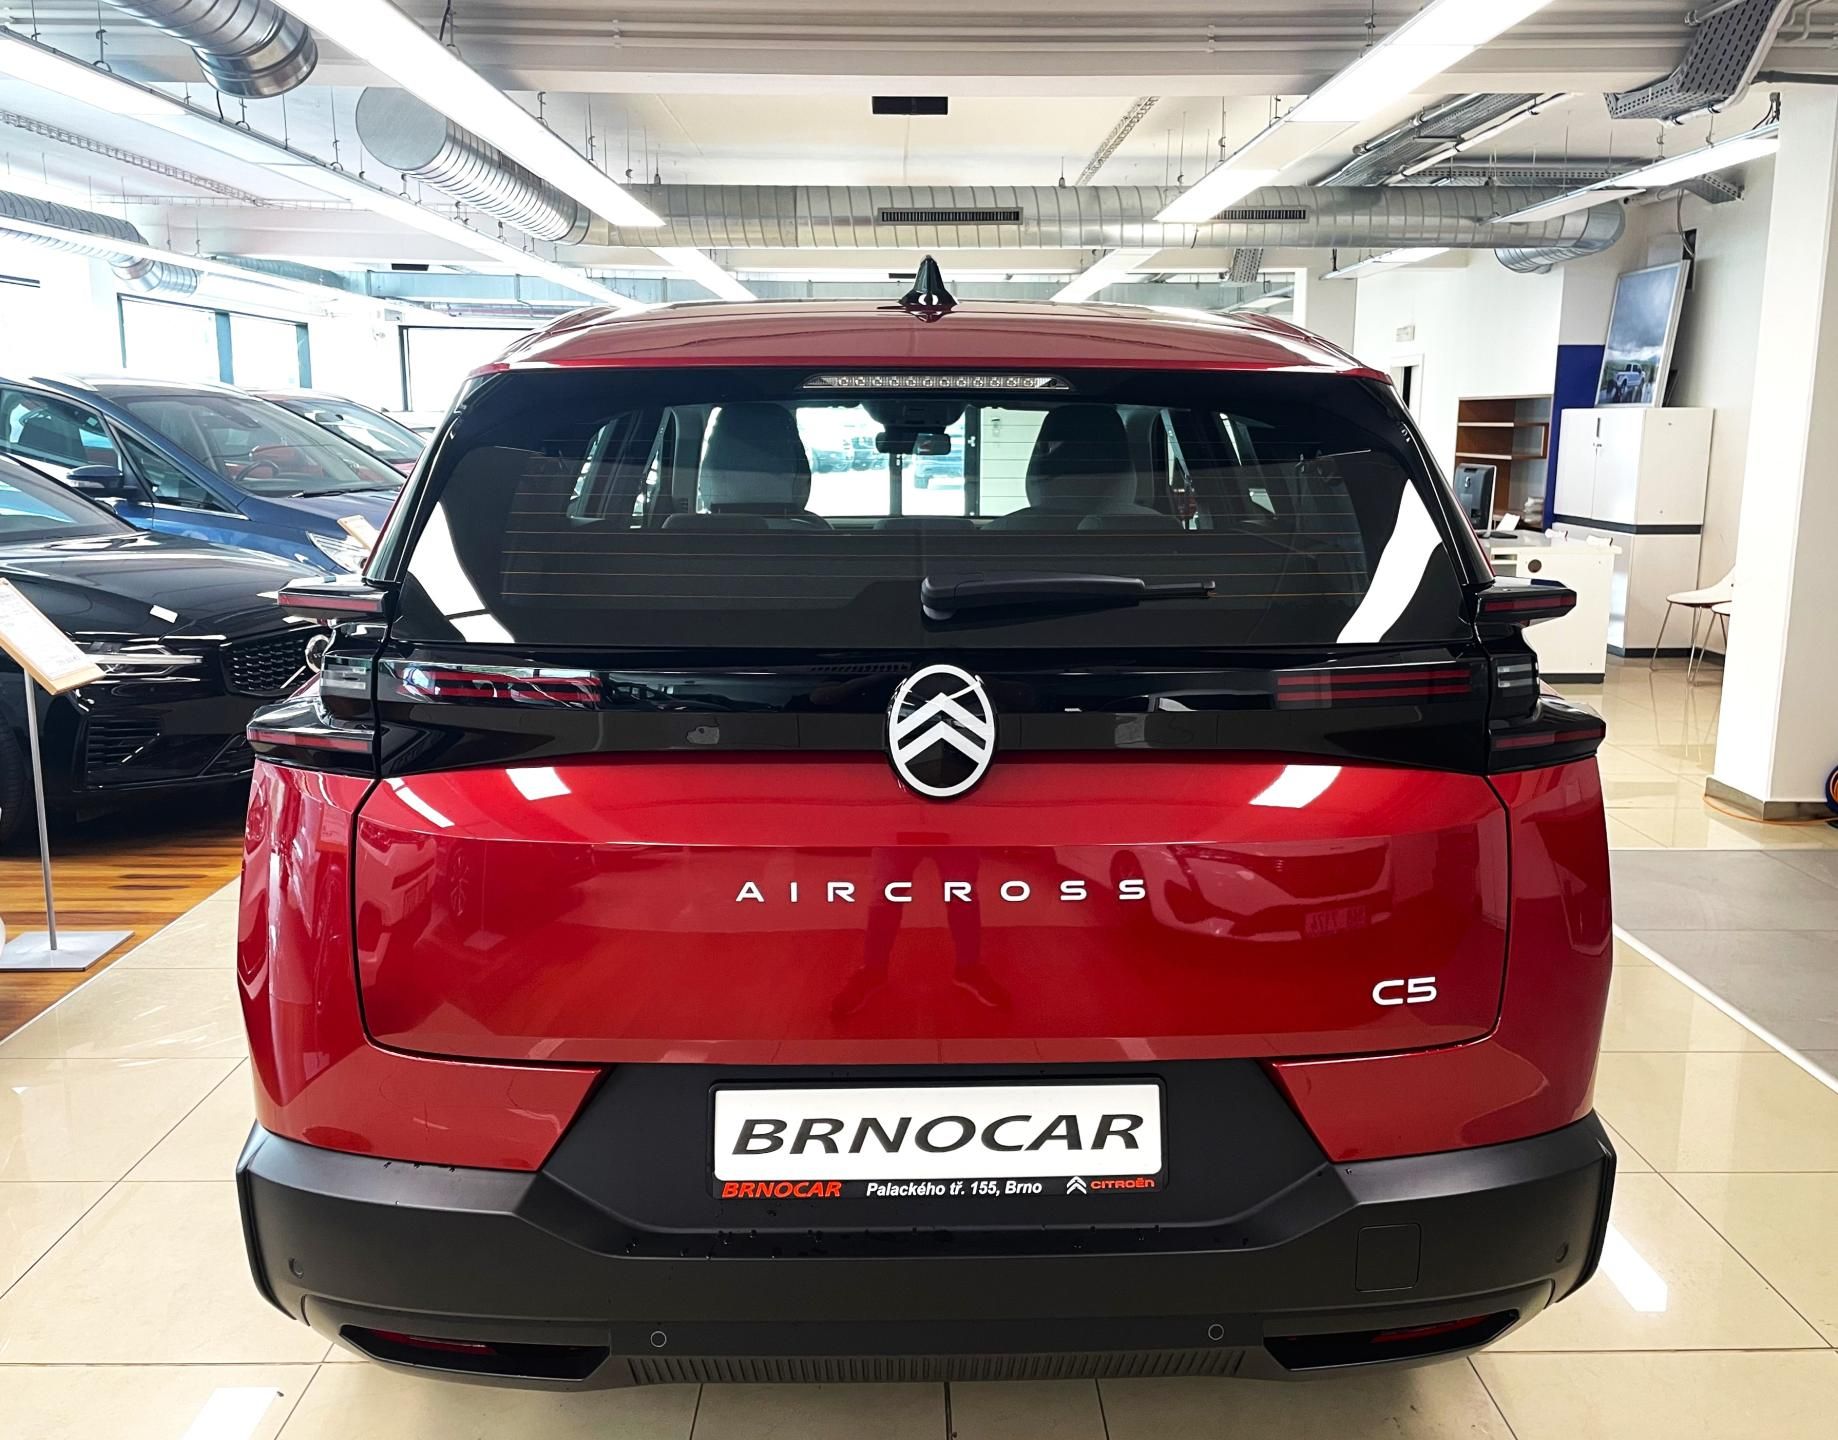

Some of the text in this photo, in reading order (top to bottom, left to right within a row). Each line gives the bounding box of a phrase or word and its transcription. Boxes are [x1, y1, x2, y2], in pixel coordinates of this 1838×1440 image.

[735, 879, 1147, 903] AIRCROSS
[1371, 975, 1438, 1006] C5
[732, 1114, 1144, 1155] BRNOCAR
[721, 1181, 842, 1198] BRNOCAR
[866, 1179, 1043, 1197] Palackého tř. 155, Brno
